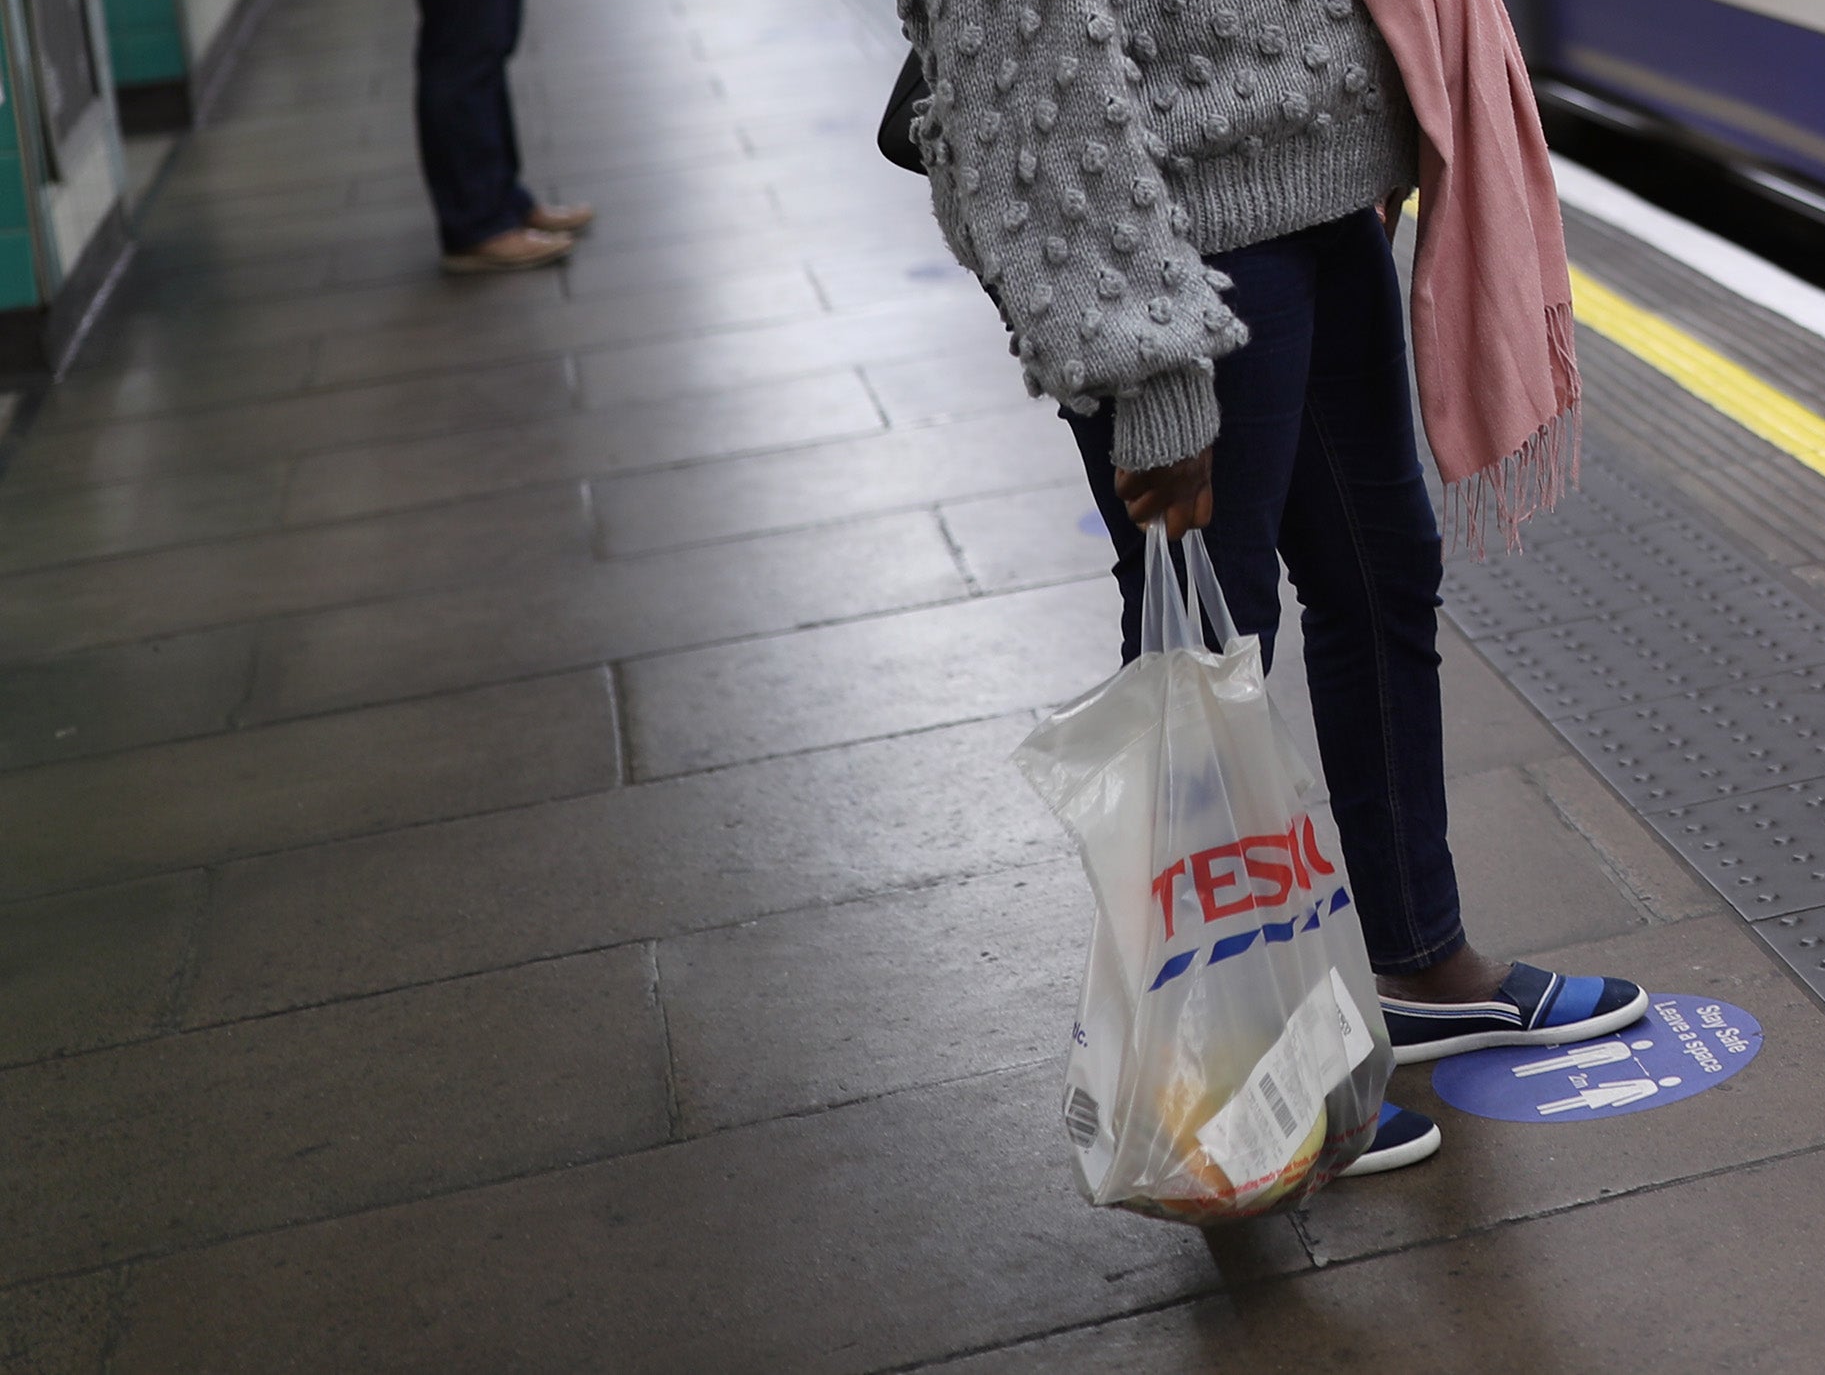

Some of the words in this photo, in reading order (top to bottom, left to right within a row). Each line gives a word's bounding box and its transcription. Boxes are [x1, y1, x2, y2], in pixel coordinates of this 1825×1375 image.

[1653, 1000, 1691, 1033] Leave
[1695, 1004, 1728, 1029] Stay
[1715, 1027, 1750, 1054] Safe
[1678, 1032, 1698, 1042] a
[1683, 1040, 1723, 1073] space
